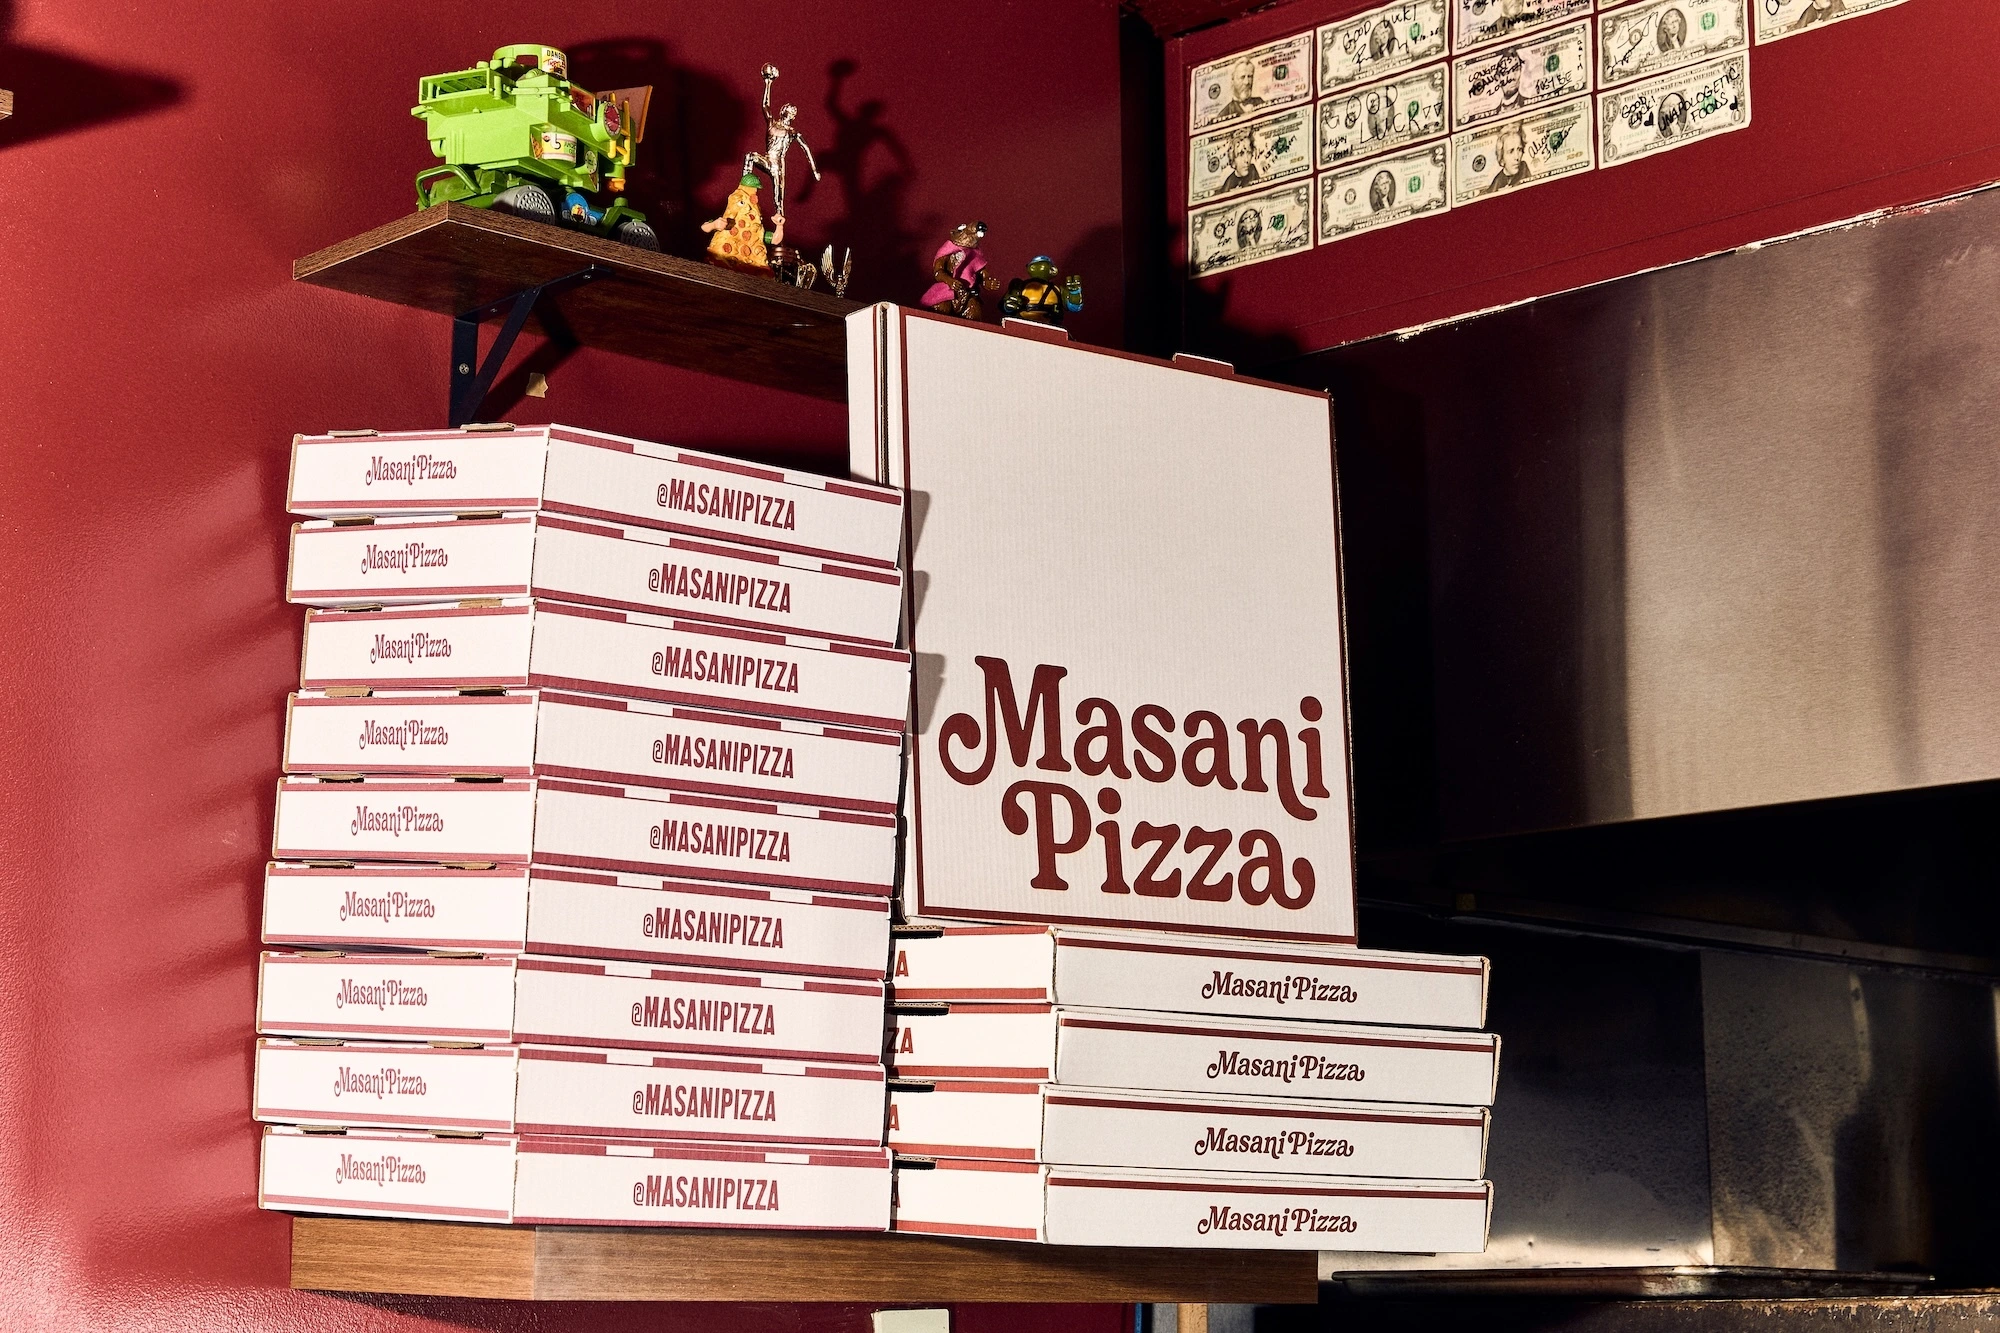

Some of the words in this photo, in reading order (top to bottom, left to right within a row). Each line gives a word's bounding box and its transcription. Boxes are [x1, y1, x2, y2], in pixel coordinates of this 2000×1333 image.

[1343, 20, 1371, 50] GOOD
[1621, 96, 1647, 118] GOOD
[1659, 67, 1740, 131] UNAPOLOGETIC
[1690, 92, 1729, 123] FOODS
[366, 455, 417, 486] Masani
[417, 454, 456, 480] Pizza
[657, 478, 794, 531] @MASANIPIZZA
[361, 543, 409, 574] Masani
[409, 542, 448, 568] Pizza
[648, 563, 790, 613] @MASANIPIZZA
[370, 633, 414, 664] Masani
[415, 633, 451, 658] Pizza
[652, 646, 798, 693] @MASANIPIZZA
[359, 720, 407, 751] Masani
[408, 720, 448, 745] Pizza
[939, 655, 1330, 821] Masani
[652, 734, 793, 779] @MASANIPIZZA
[351, 806, 401, 837] Masani
[402, 806, 443, 832] Pizza
[650, 819, 790, 862] @MASANIPIZZA
[1001, 780, 1316, 910] Pizza
[340, 891, 391, 923] Masani
[392, 892, 435, 918] Pizza
[643, 907, 783, 948] @MASANIPIZZA
[337, 979, 386, 1011] Masani
[387, 980, 427, 1006] Pizza
[1202, 971, 1291, 1004] Masani
[1292, 977, 1357, 1003] Pizza
[632, 996, 775, 1035] @MASANIPIZZA
[334, 1067, 384, 1099] Masani
[385, 1068, 426, 1095] Pizza
[1207, 1051, 1298, 1083] Masani
[1299, 1056, 1365, 1081] Pizza
[633, 1084, 776, 1121] @MASANIPIZZA
[1195, 1127, 1287, 1159] Masani
[1288, 1131, 1354, 1157] Pizza
[336, 1154, 385, 1187] Masani
[386, 1156, 425, 1184] Pizza
[633, 1175, 779, 1211] @MASANIPIZZA
[1197, 1206, 1290, 1237] Masani
[1291, 1208, 1357, 1233] Pizza
